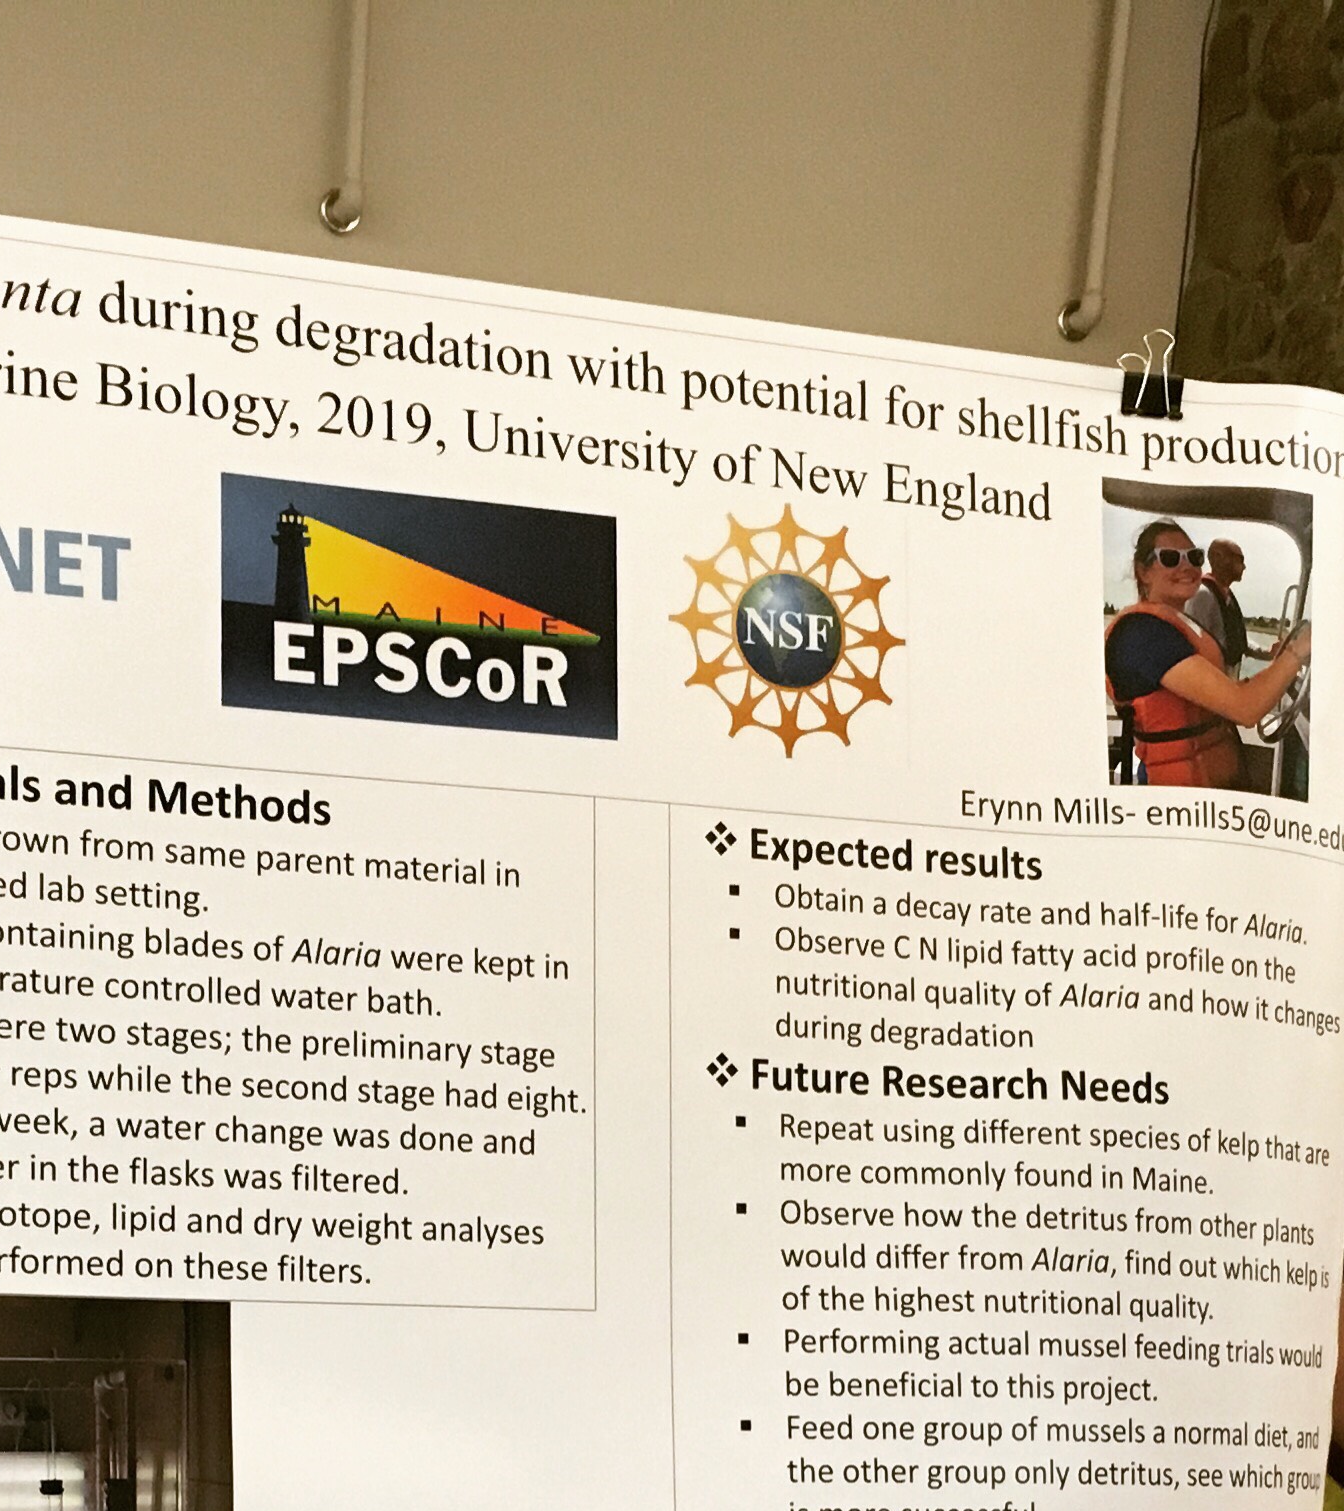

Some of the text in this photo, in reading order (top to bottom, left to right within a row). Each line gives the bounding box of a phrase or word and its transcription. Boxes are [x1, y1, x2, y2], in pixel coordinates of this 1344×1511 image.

[99, 280, 258, 353] during
[276, 304, 552, 380] degradation
[567, 346, 666, 395] with
[681, 370, 869, 422] potential
[885, 385, 944, 431] for
[958, 399, 1128, 457] shellfish
[96, 362, 299, 439] Biology,
[317, 391, 446, 455] 2019,
[463, 409, 698, 487] University
[713, 446, 761, 489] of
[771, 446, 868, 500] New
[883, 463, 1052, 521] England
[313, 595, 559, 636] MAINE
[743, 606, 834, 653] NSF
[274, 620, 568, 708] EPSCoR
[55, 774, 131, 810] and
[148, 779, 331, 826] Methods
[961, 790, 1043, 823] Erynn
[1054, 797, 1135, 825] Mills-
[79, 829, 153, 862] from
[165, 844, 245, 868] same
[257, 850, 354, 876] parent
[365, 857, 485, 885] material
[496, 861, 519, 888] in
[751, 828, 1042, 880] Expected results
[775, 883, 1308, 946] Obtain a decay rate and half-life for Alaria.
[752, 1058, 1169, 1105] Future Research Needs
